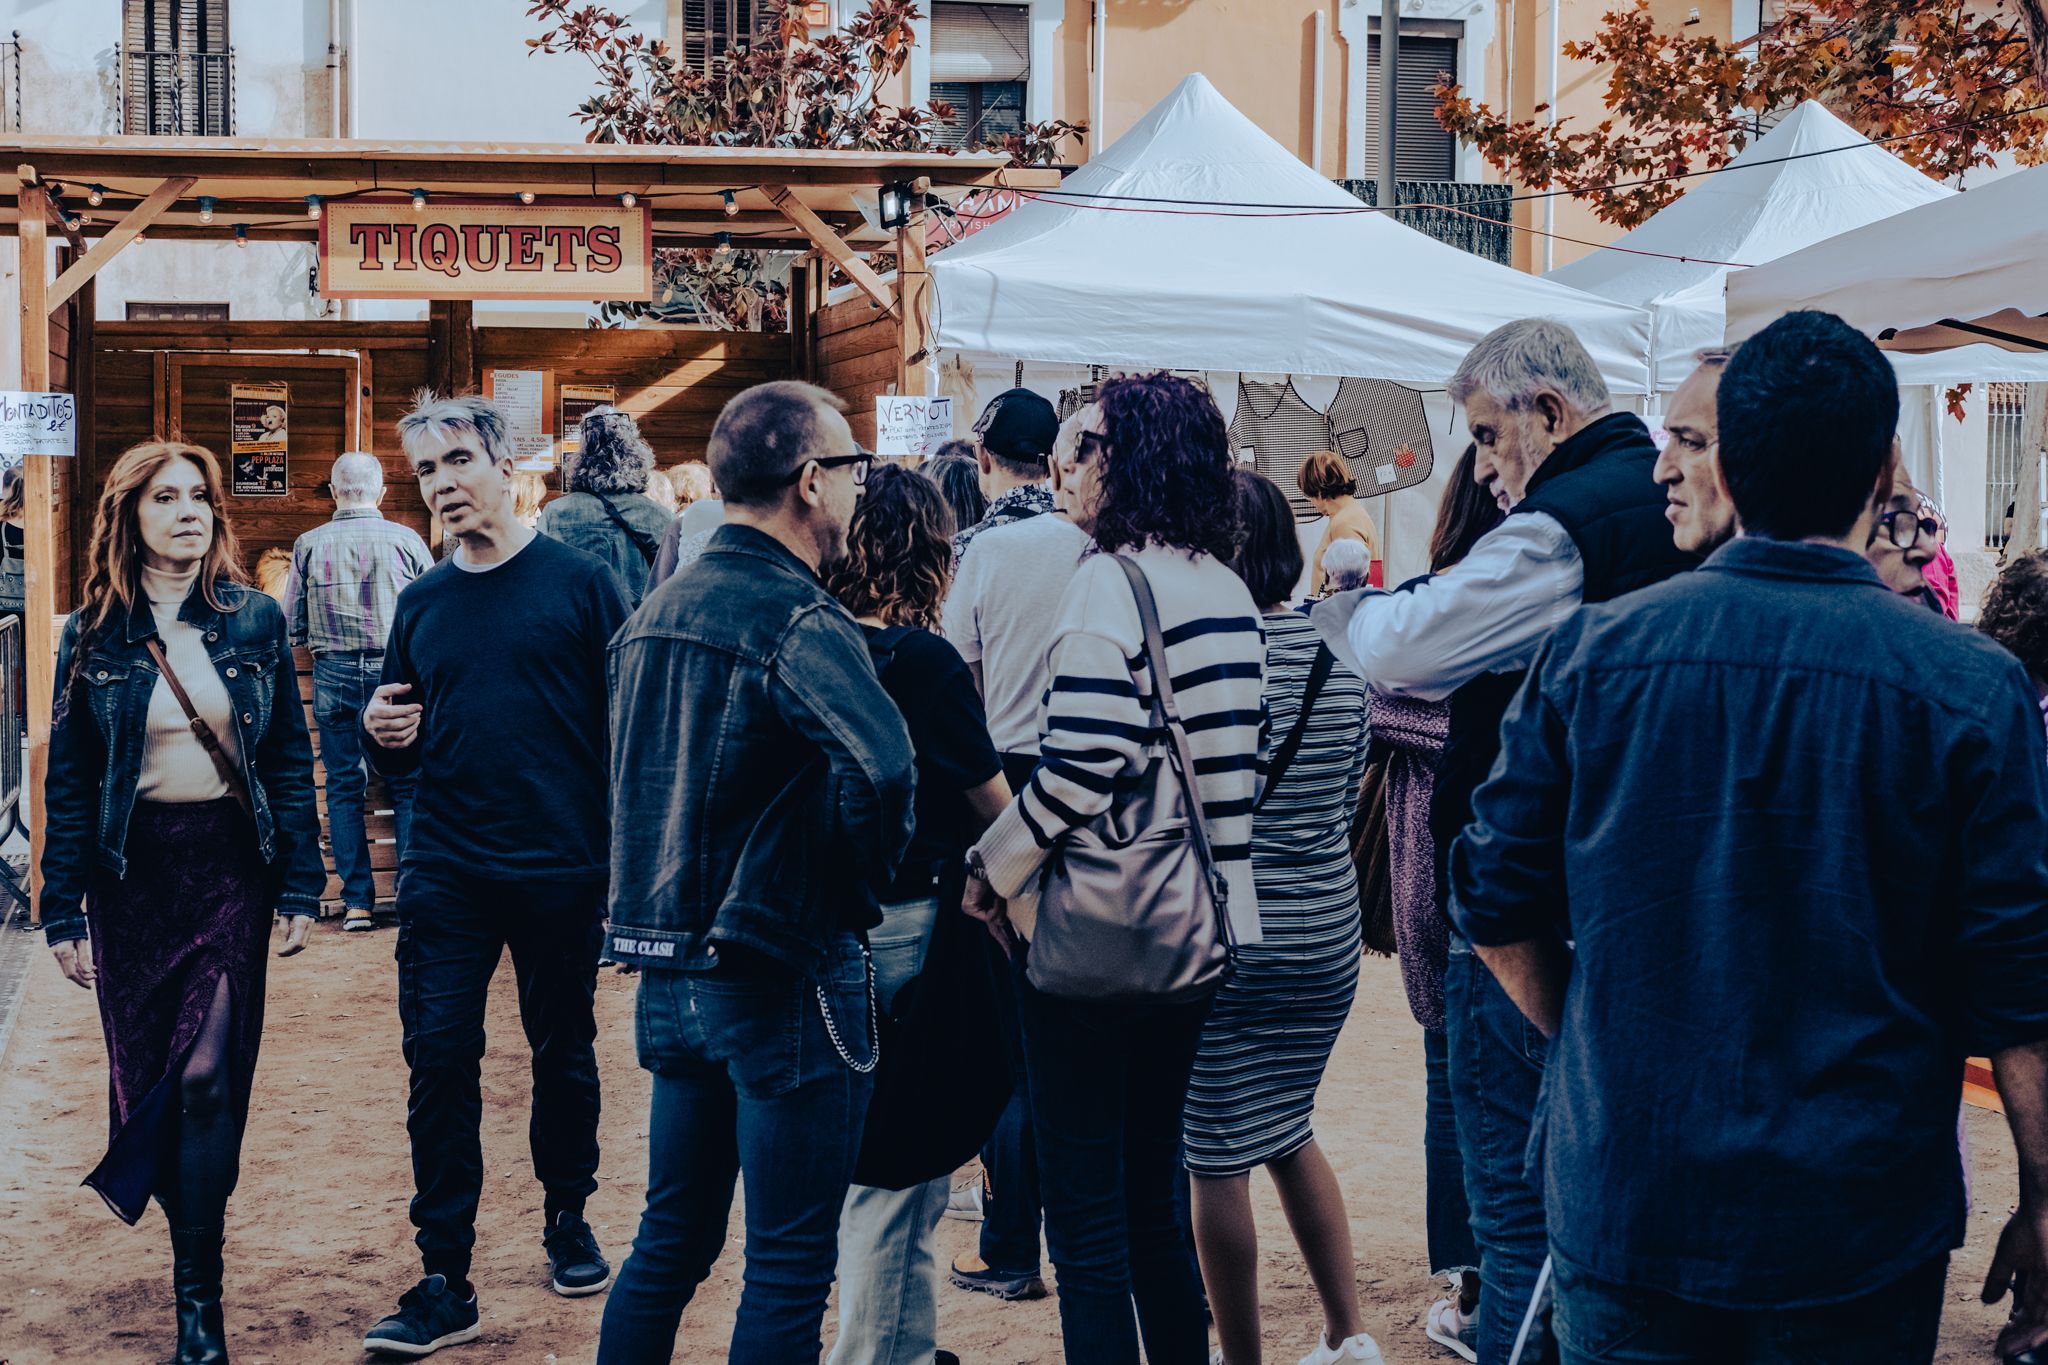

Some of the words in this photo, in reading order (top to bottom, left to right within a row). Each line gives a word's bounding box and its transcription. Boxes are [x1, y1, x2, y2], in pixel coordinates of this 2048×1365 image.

[350, 223, 622, 277] TIQUETS
[880, 399, 950, 424] VERMUT
[47, 420, 67, 432] 2€
[252, 456, 264, 464] PEP
[264, 455, 284, 464] PLAZA
[613, 937, 637, 954] THE
[638, 941, 675, 957] CLASH
